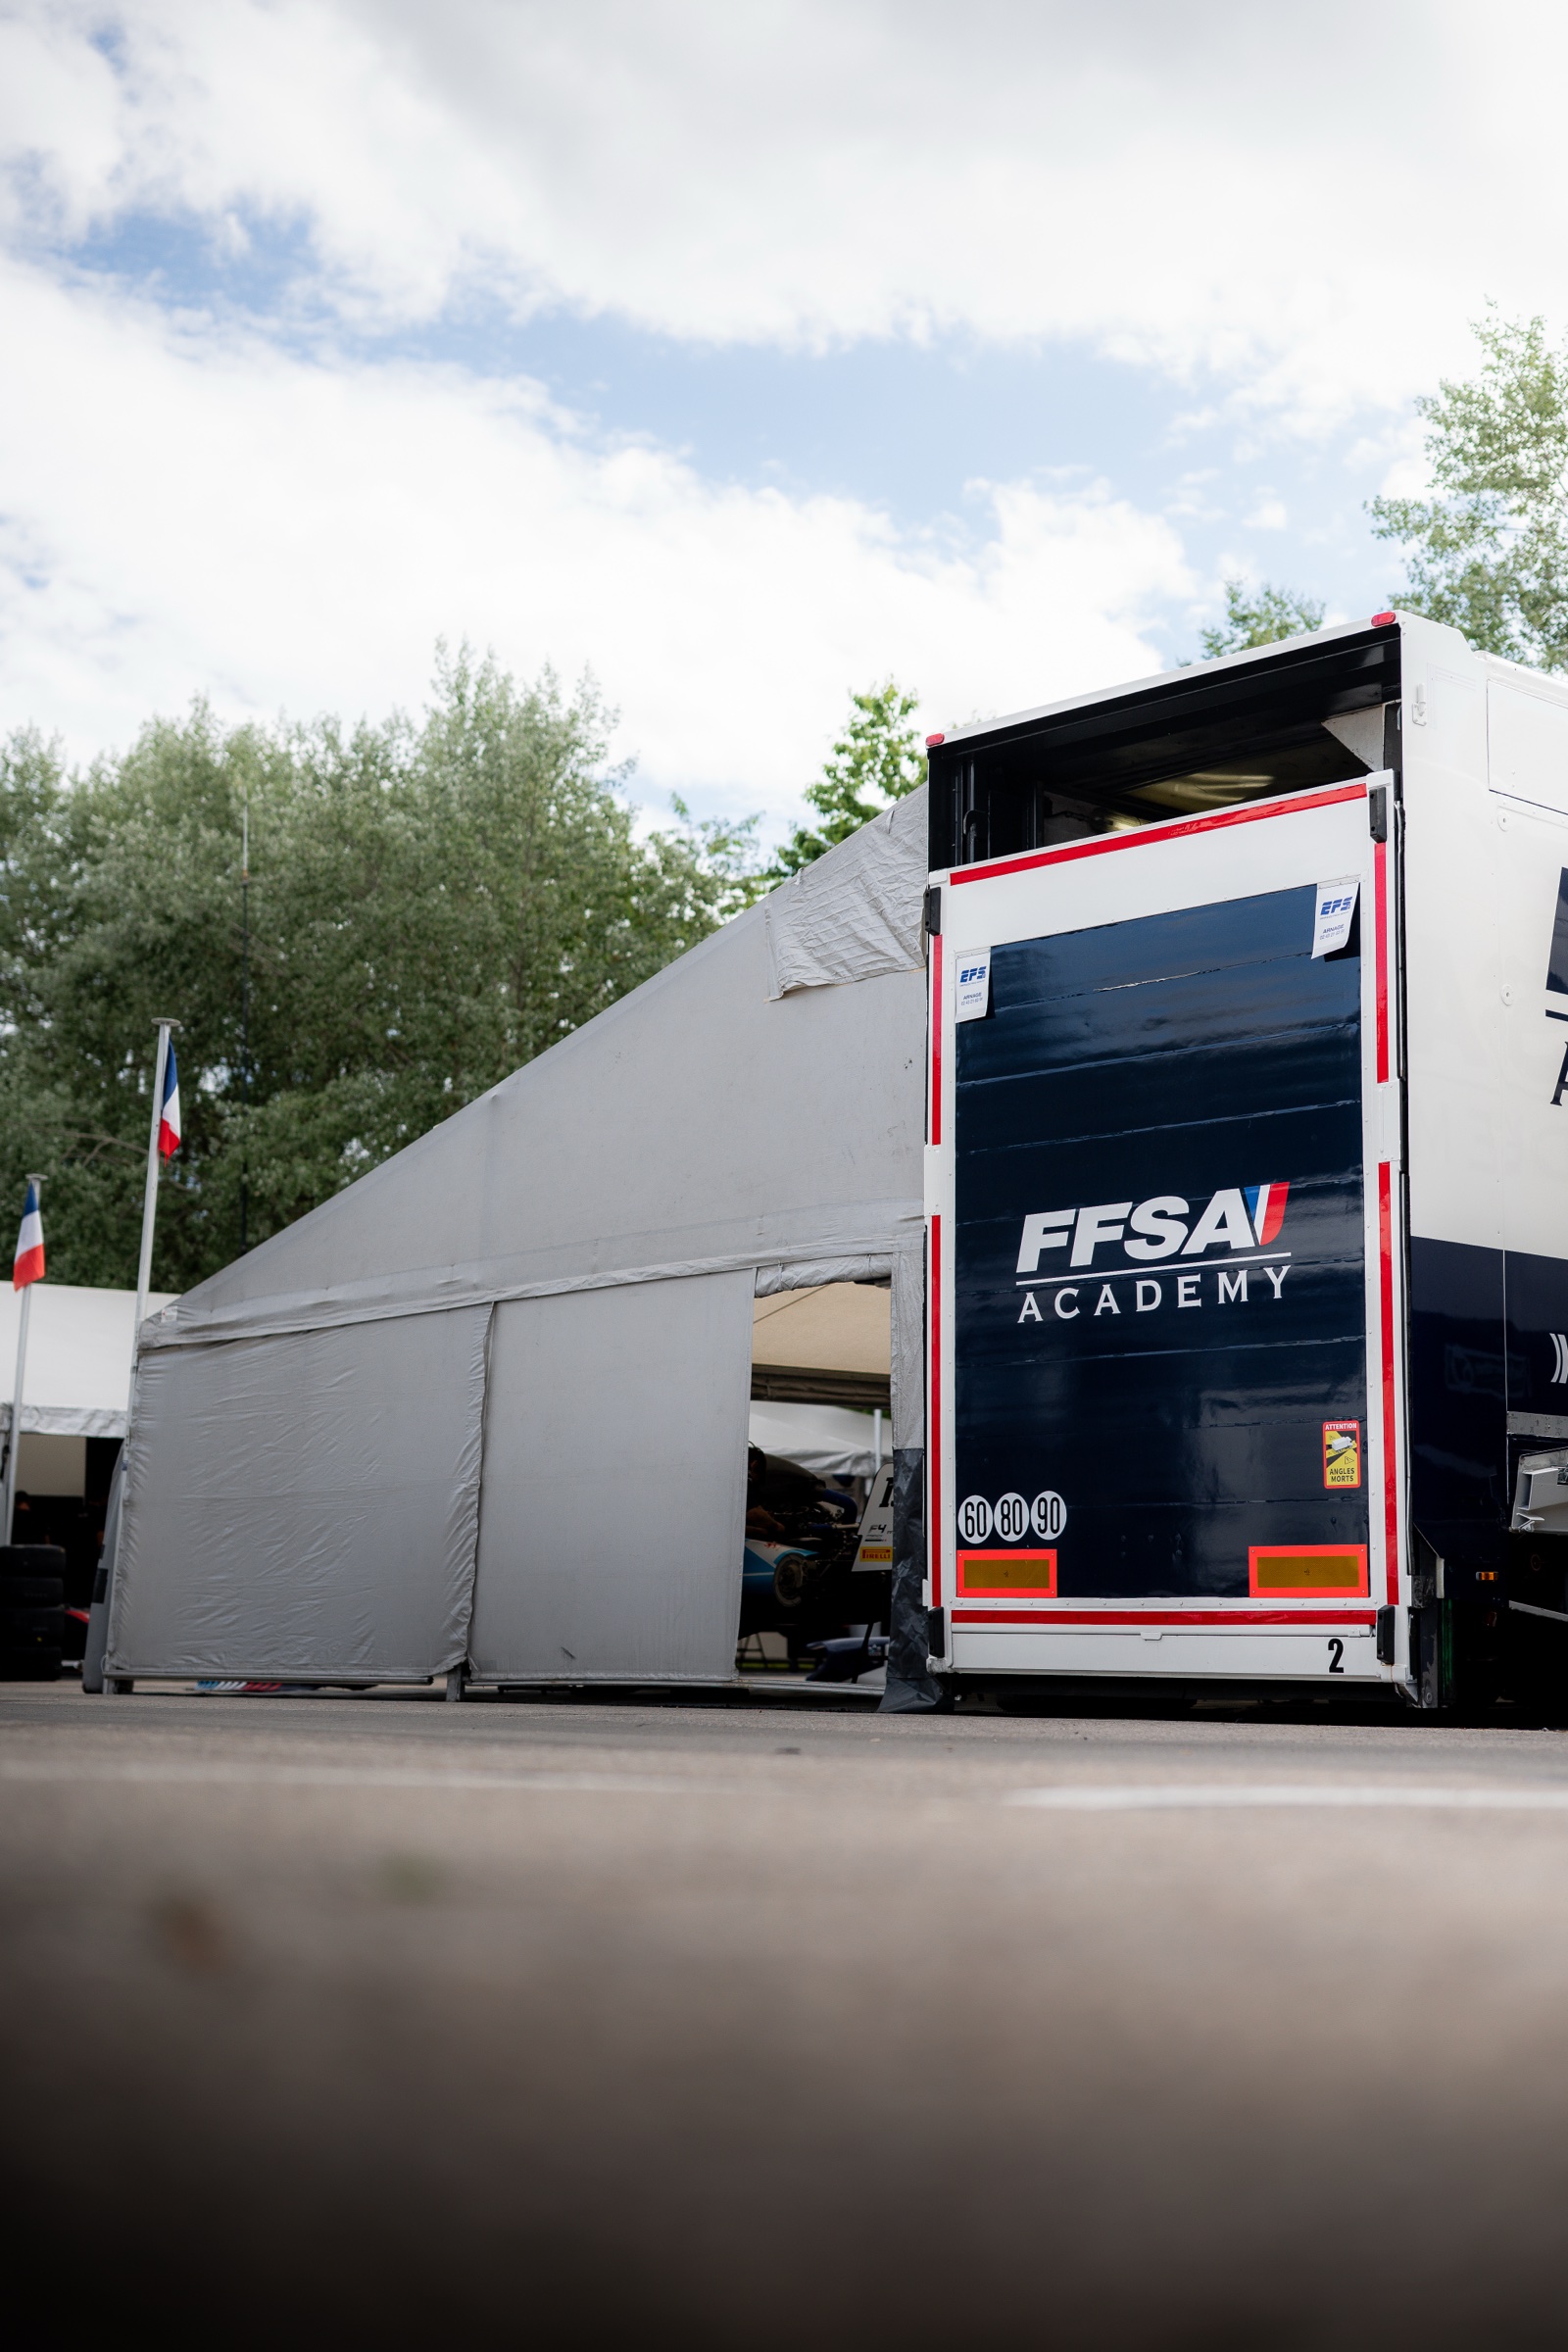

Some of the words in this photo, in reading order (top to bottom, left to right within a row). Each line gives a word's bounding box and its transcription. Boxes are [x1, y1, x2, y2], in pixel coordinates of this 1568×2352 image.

[1016, 1187, 1255, 1273] FFSA
[1017, 1264, 1292, 1323] ACADEMY
[1325, 1422, 1357, 1431] ATTENTION
[1329, 1467, 1355, 1476] ANGLES
[964, 1500, 987, 1538] 60
[1001, 1498, 1023, 1536] 80
[1037, 1496, 1060, 1534] 90
[868, 1524, 887, 1534] F4
[862, 1548, 891, 1559] PIRELLI
[1328, 1638, 1345, 1674] 2
